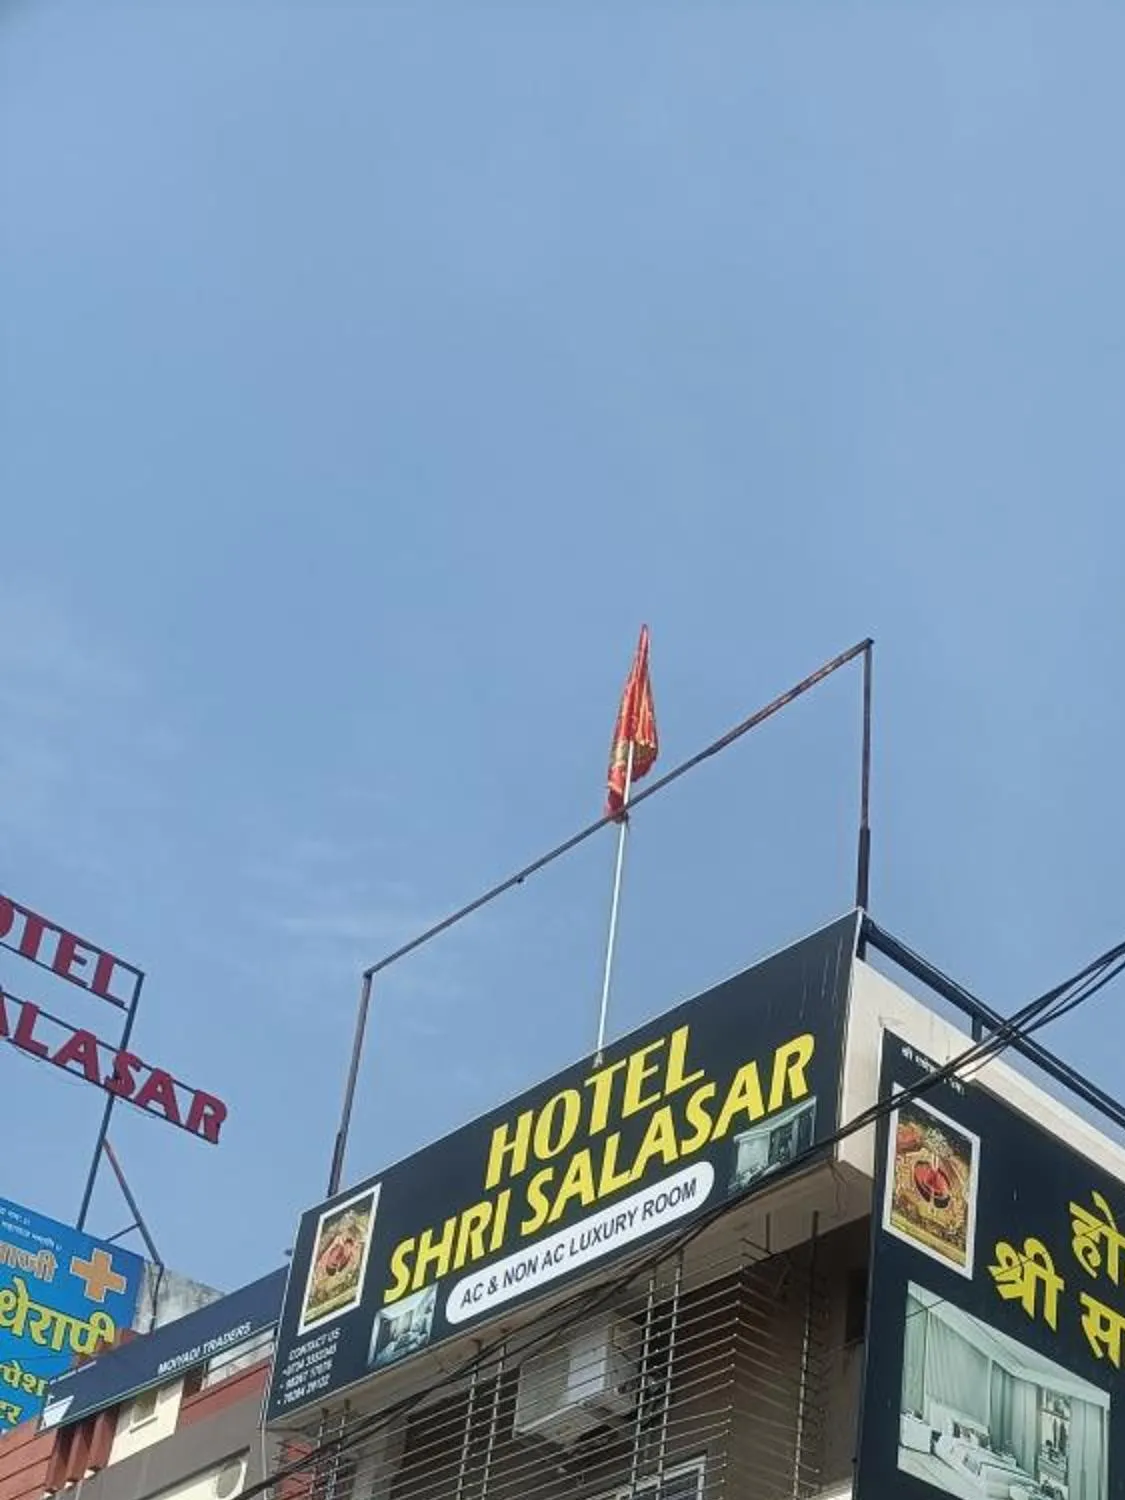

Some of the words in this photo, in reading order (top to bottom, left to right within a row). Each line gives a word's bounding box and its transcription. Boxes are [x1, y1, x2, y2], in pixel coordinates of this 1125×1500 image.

[383, 1189, 511, 1304] SHRI
[520, 1032, 816, 1237] SALASAR
[485, 1024, 705, 1190] HOTEL
[459, 1282, 485, 1308] AC
[487, 1275, 498, 1296] &
[502, 1257, 540, 1289] NON
[541, 1244, 565, 1272] AC
[569, 1208, 640, 1256] LUXURY
[641, 1177, 698, 1221] ROOM
[988, 1237, 1065, 1333] श्री
